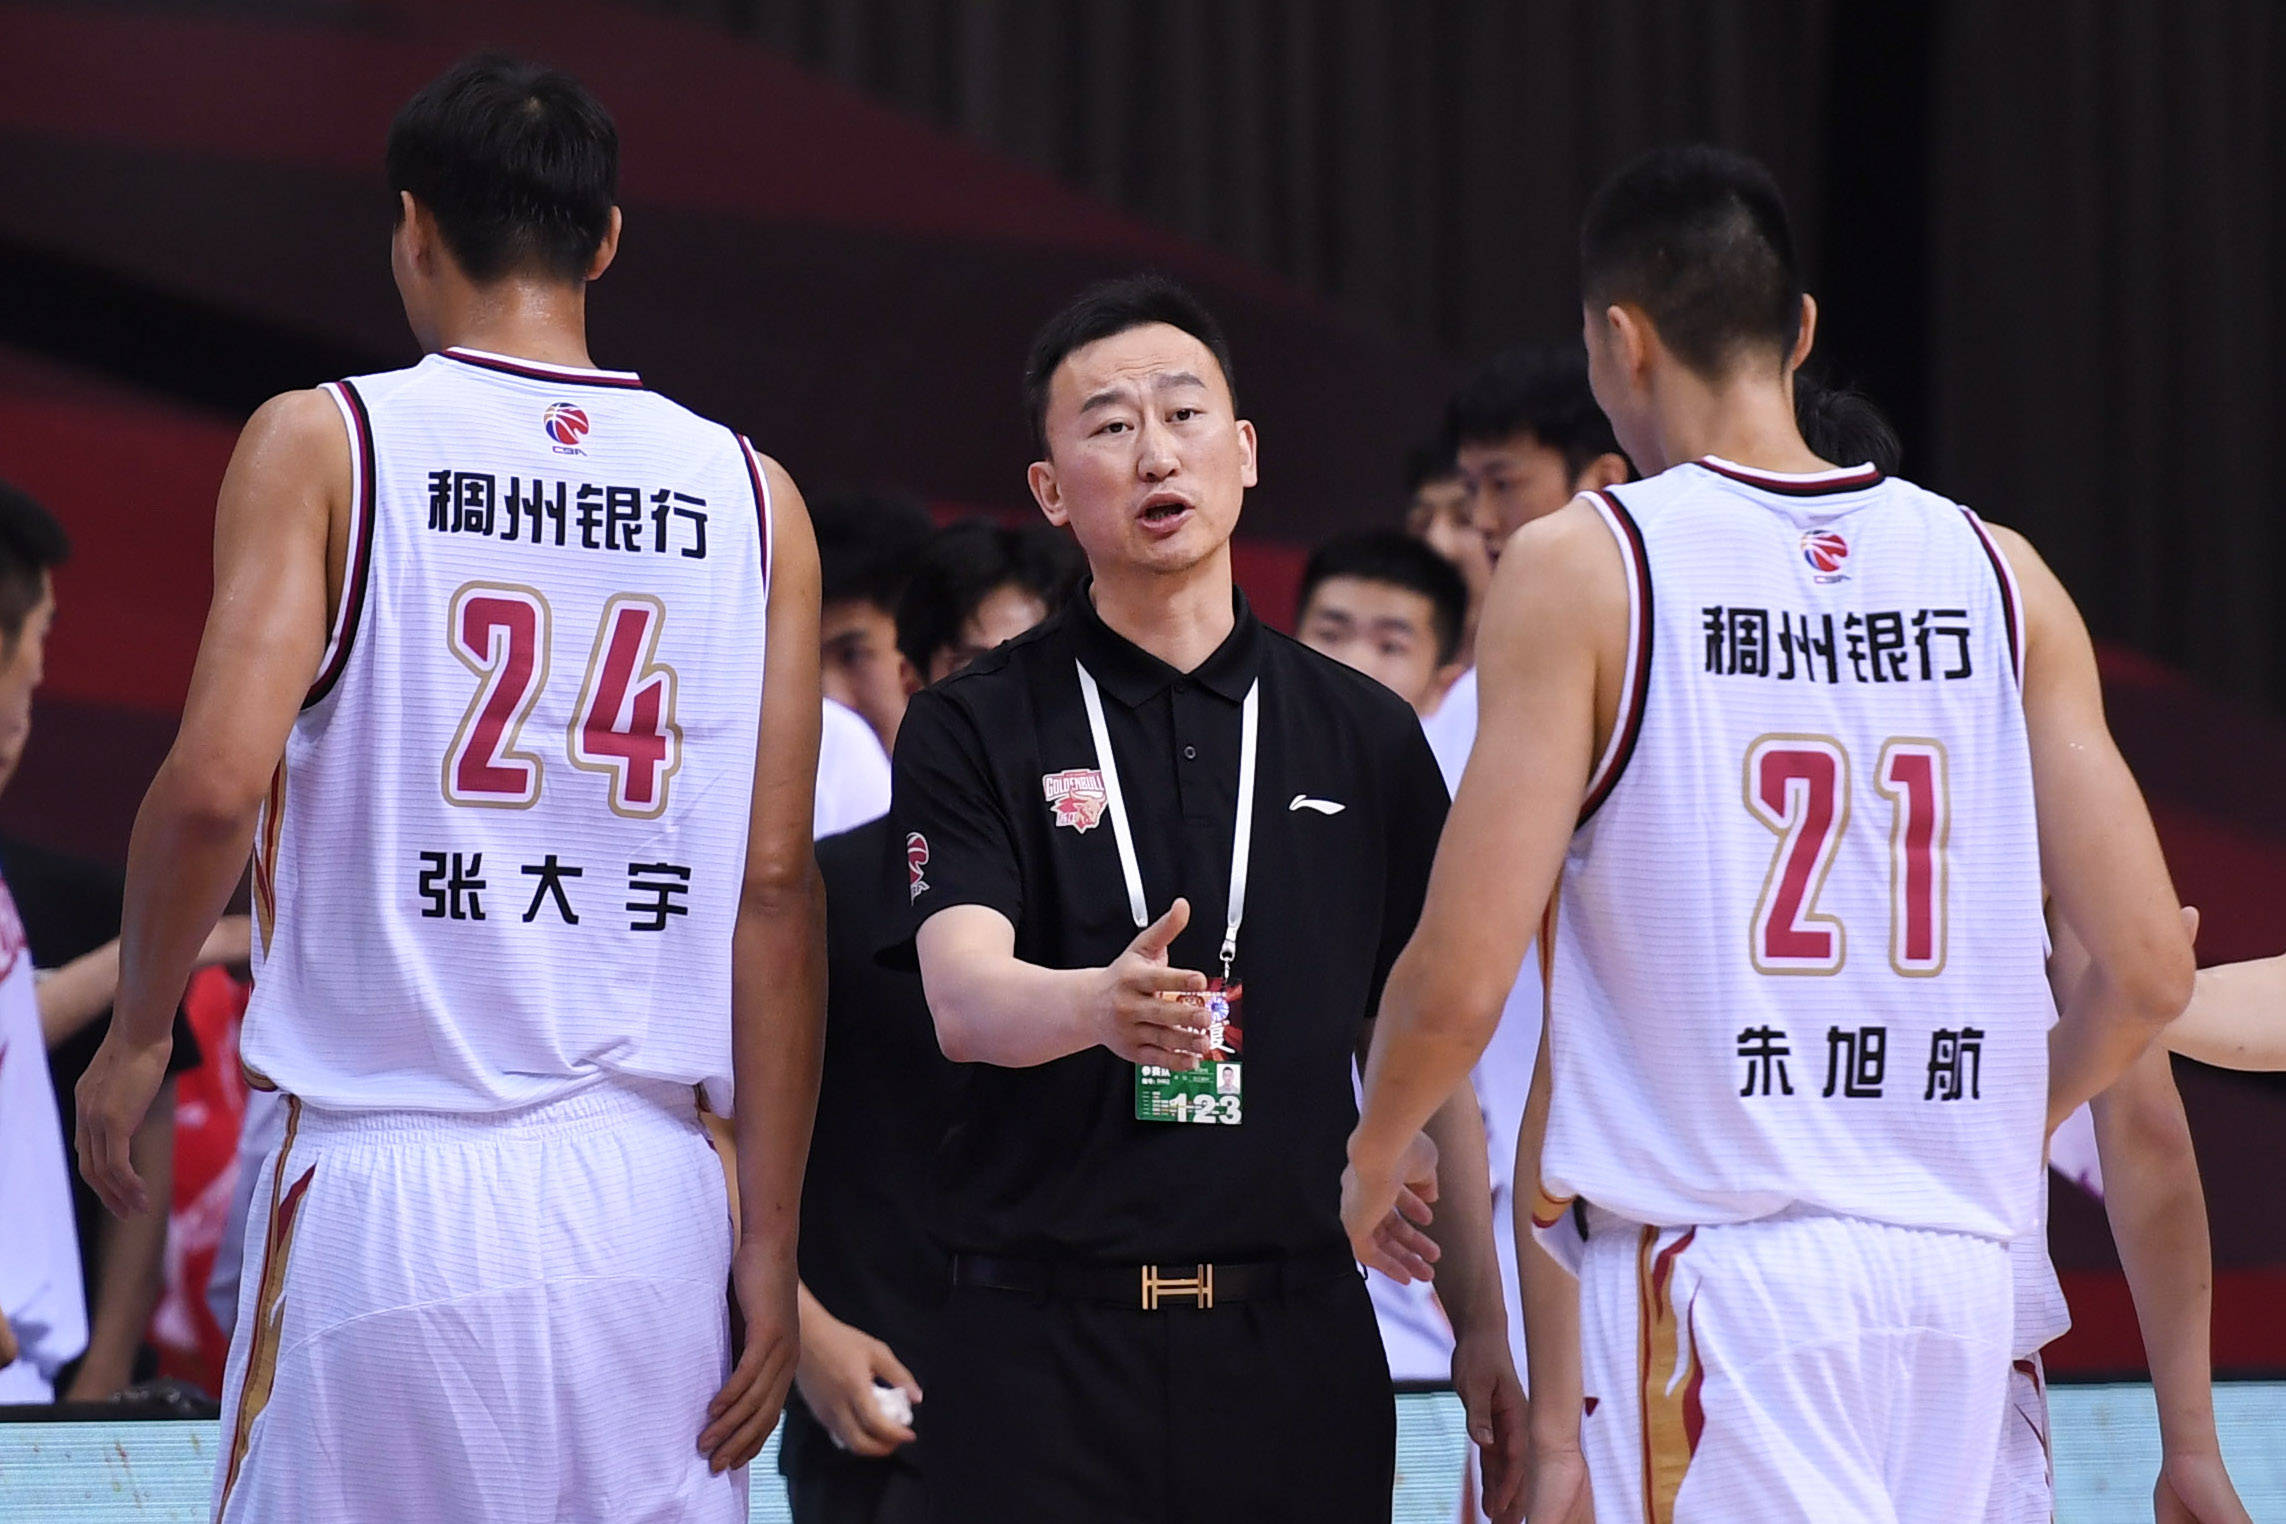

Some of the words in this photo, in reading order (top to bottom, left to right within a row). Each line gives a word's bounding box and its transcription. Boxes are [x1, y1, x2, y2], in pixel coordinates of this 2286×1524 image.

[428, 469, 708, 559] 稠州银行
[1702, 606, 1972, 684] 稠州银行
[442, 580, 683, 820] 24
[419, 851, 691, 931] 张大宇
[1742, 732, 1951, 977] 21
[1737, 1025, 1985, 1101] 朱旭航
[1169, 1093, 1242, 1125] 123
